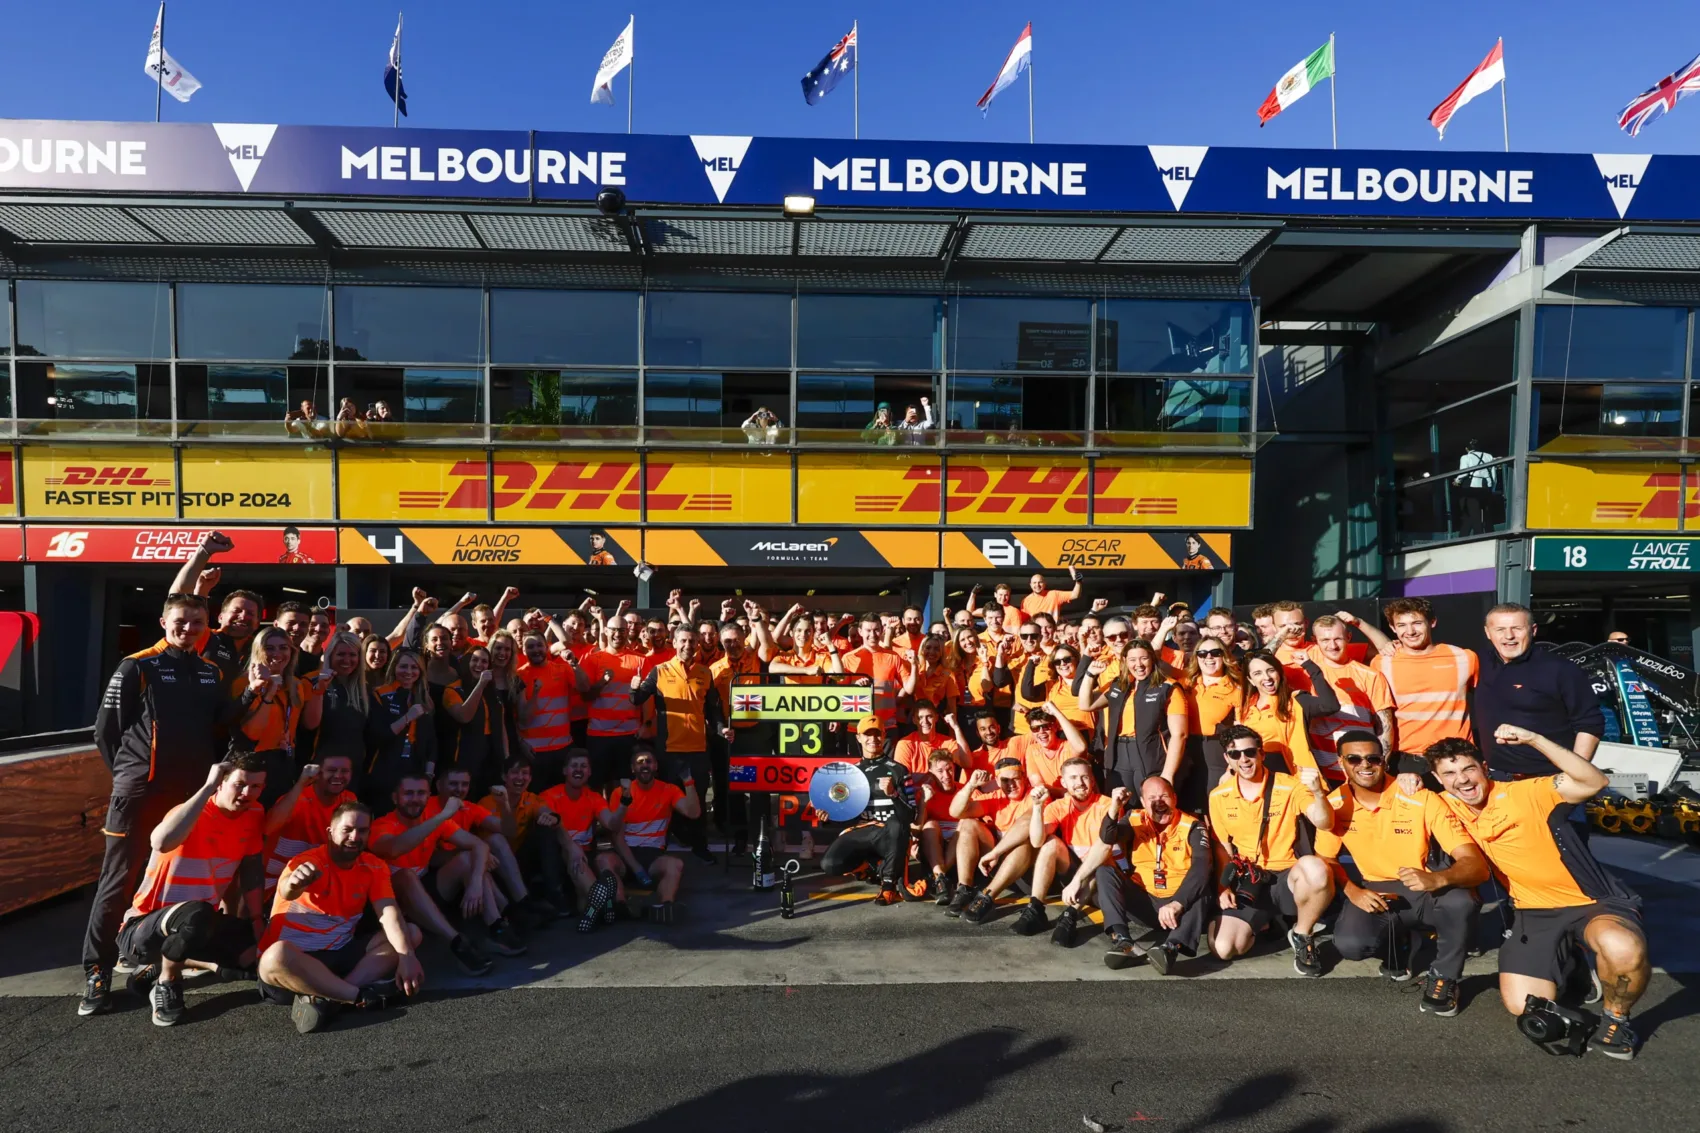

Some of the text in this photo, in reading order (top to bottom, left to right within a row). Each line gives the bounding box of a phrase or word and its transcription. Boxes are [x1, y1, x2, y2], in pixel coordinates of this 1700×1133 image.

[225, 144, 261, 160] MEL
[341, 145, 627, 186] MELBOURNE
[701, 157, 736, 172] MEL
[813, 157, 1087, 196] MELBOURNE
[1159, 166, 1194, 181] MEL
[1604, 174, 1638, 188] MEL
[1267, 167, 1533, 203] MELBOURNE
[62, 467, 154, 486] DHL
[442, 460, 689, 510] DHL
[898, 464, 1124, 514] DHL
[45, 490, 292, 507] FASTEST PIT STOP 2024
[46, 531, 89, 557] 16
[135, 531, 208, 545] CHARLE
[456, 534, 520, 547] LANDO
[750, 542, 829, 551] McLaren
[1062, 538, 1121, 552] OSCAR
[451, 549, 522, 562] NORRIS
[1563, 545, 1587, 568] 18
[1632, 542, 1691, 555] LANCE
[1057, 553, 1127, 566] PIASTRI
[1627, 556, 1691, 570] STROLL
[762, 695, 841, 712] LANDO
[779, 723, 822, 755] P3
[763, 765, 819, 784] OSC
[778, 795, 818, 828] P4
